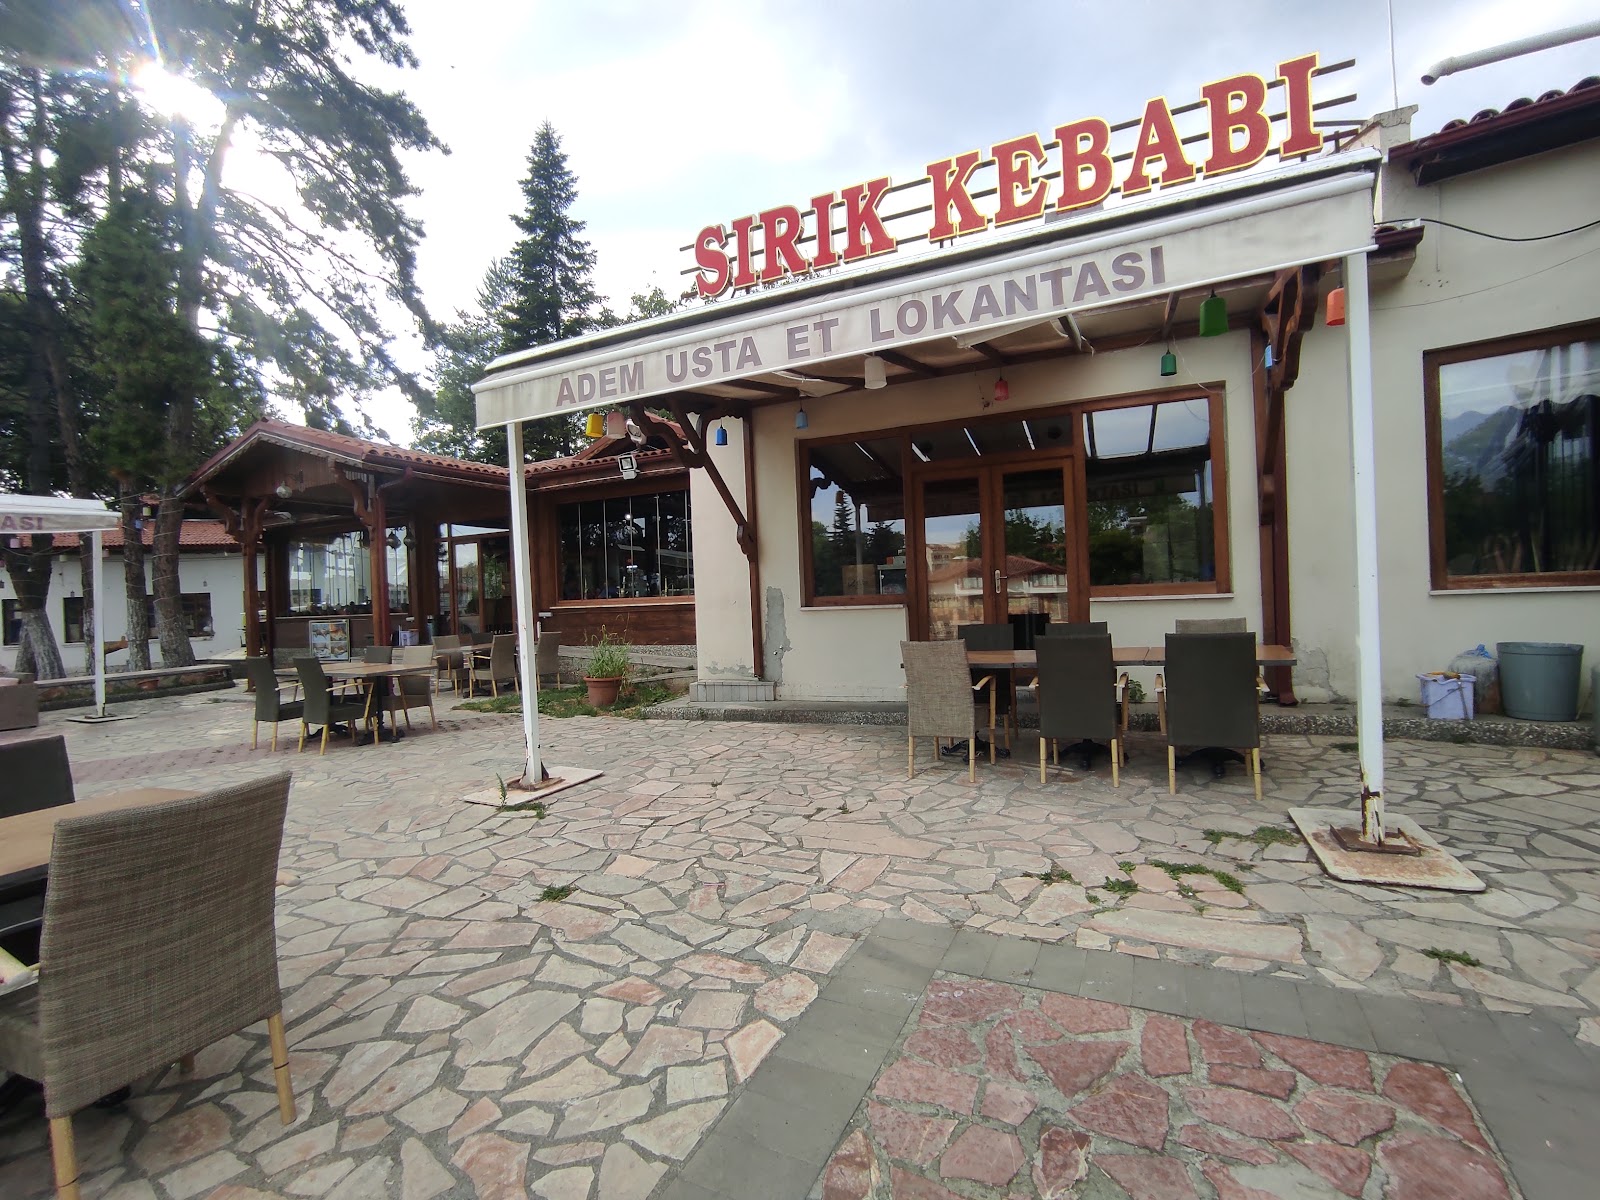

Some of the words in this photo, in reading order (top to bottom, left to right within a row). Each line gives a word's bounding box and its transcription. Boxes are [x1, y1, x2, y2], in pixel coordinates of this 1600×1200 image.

[694, 175, 899, 299] SIRIK
[926, 52, 1323, 243] KEBABI
[556, 360, 645, 407] ADEM
[666, 336, 763, 383] USTA
[786, 317, 840, 360] ET
[869, 245, 1167, 343] LOKANTASI
